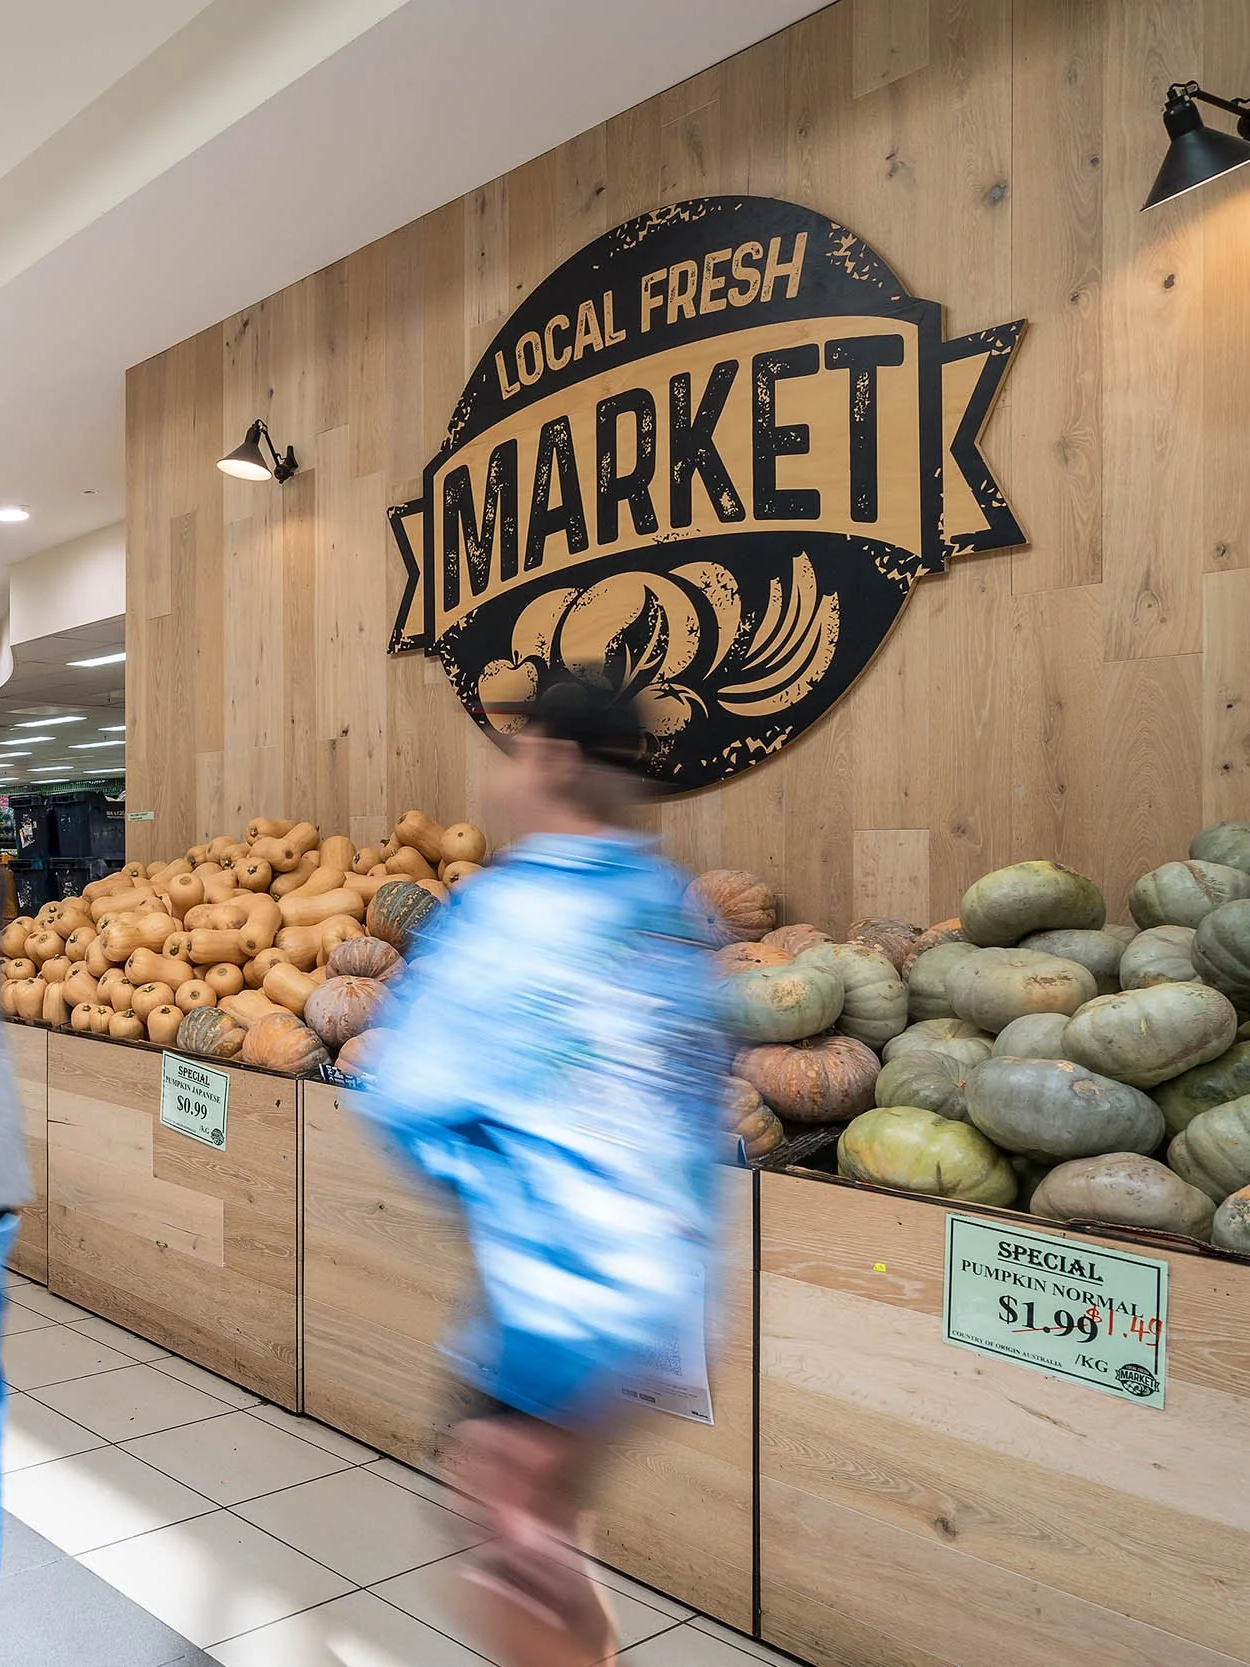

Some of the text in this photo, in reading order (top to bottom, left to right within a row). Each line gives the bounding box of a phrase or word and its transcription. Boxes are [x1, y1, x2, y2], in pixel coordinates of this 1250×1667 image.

[494, 231, 809, 401] LOCAL FRESH
[442, 333, 905, 613] MARKET
[165, 1075, 221, 1104] PUMPKIN JAPANESE
[178, 1065, 210, 1086] SPECIAL
[176, 1094, 208, 1120] $0.99
[998, 1241, 1104, 1282] SPECIAL
[961, 1259, 1144, 1319] PUMPKIN NORMAL
[998, 1294, 1099, 1344] $1.99
[952, 1329, 984, 1345] COUNTRY
[995, 1342, 1021, 1356] ORIGIN
[1022, 1351, 1063, 1369] AUSTRALIA
[1074, 1353, 1109, 1374] /KG
[1120, 1369, 1155, 1388] MARKET
